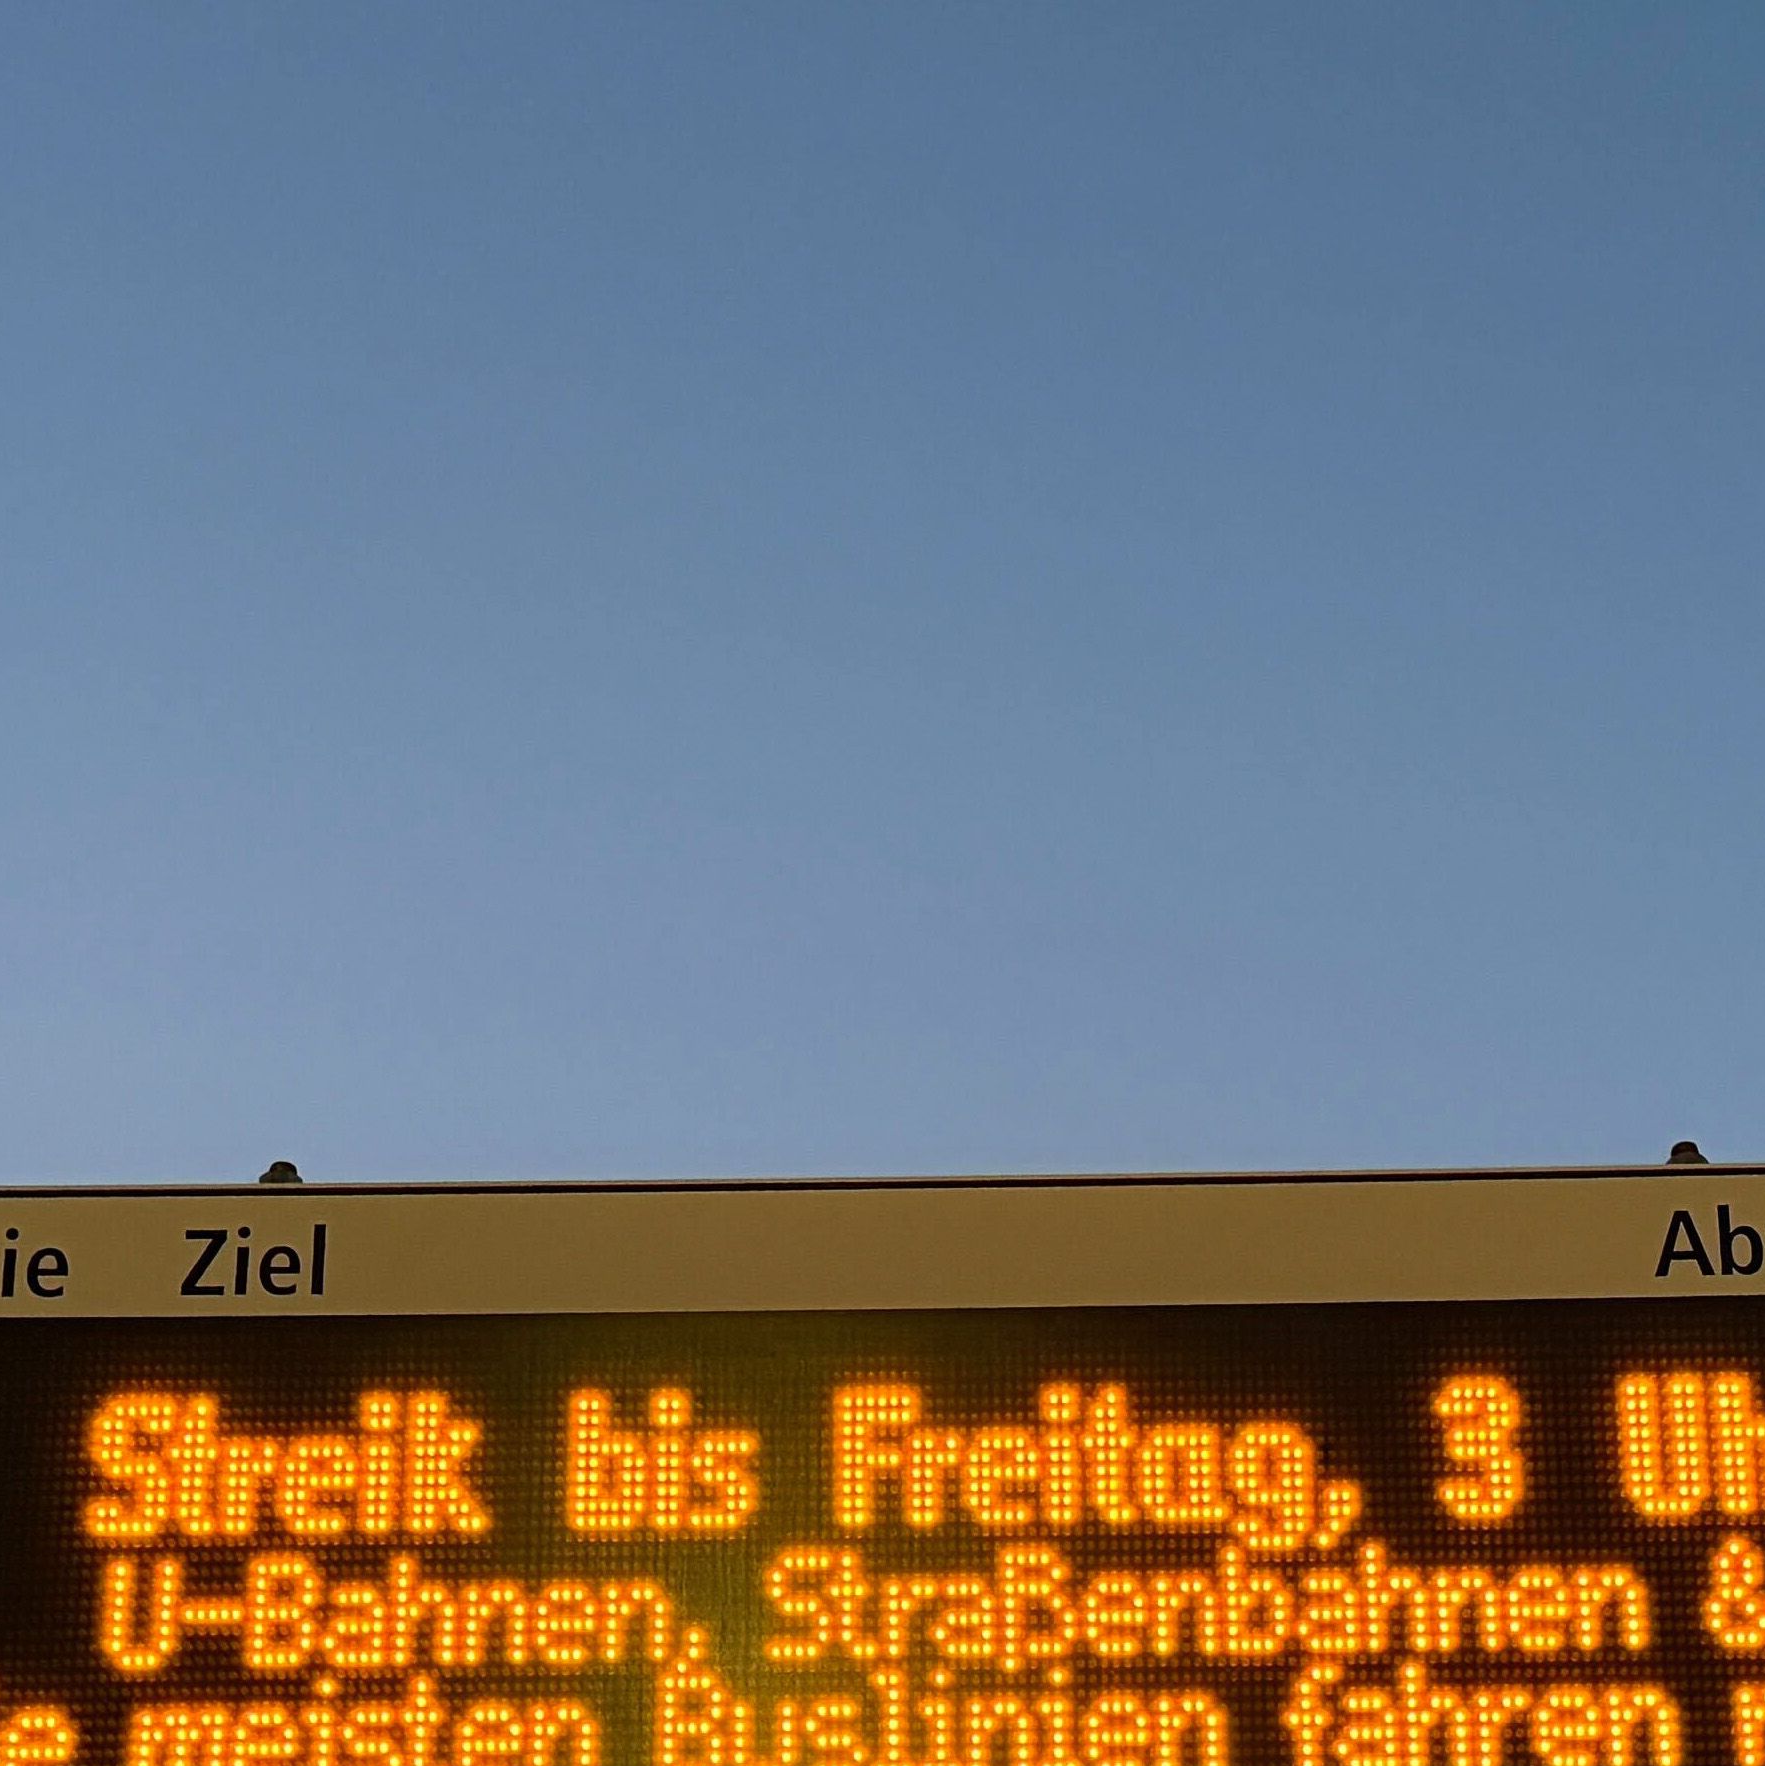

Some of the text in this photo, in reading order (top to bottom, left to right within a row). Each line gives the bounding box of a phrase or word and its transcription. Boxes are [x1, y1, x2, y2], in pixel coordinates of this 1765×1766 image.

[179, 1223, 328, 1297] Ziel
[85, 1391, 492, 1542] Streik
[565, 1387, 760, 1534] bis
[830, 1381, 1363, 1553] Freitag,
[1433, 1375, 1525, 1523] 3
[99, 1551, 708, 1670] U-Bahnen,
[762, 1541, 1651, 1672] Straßenbahnen
